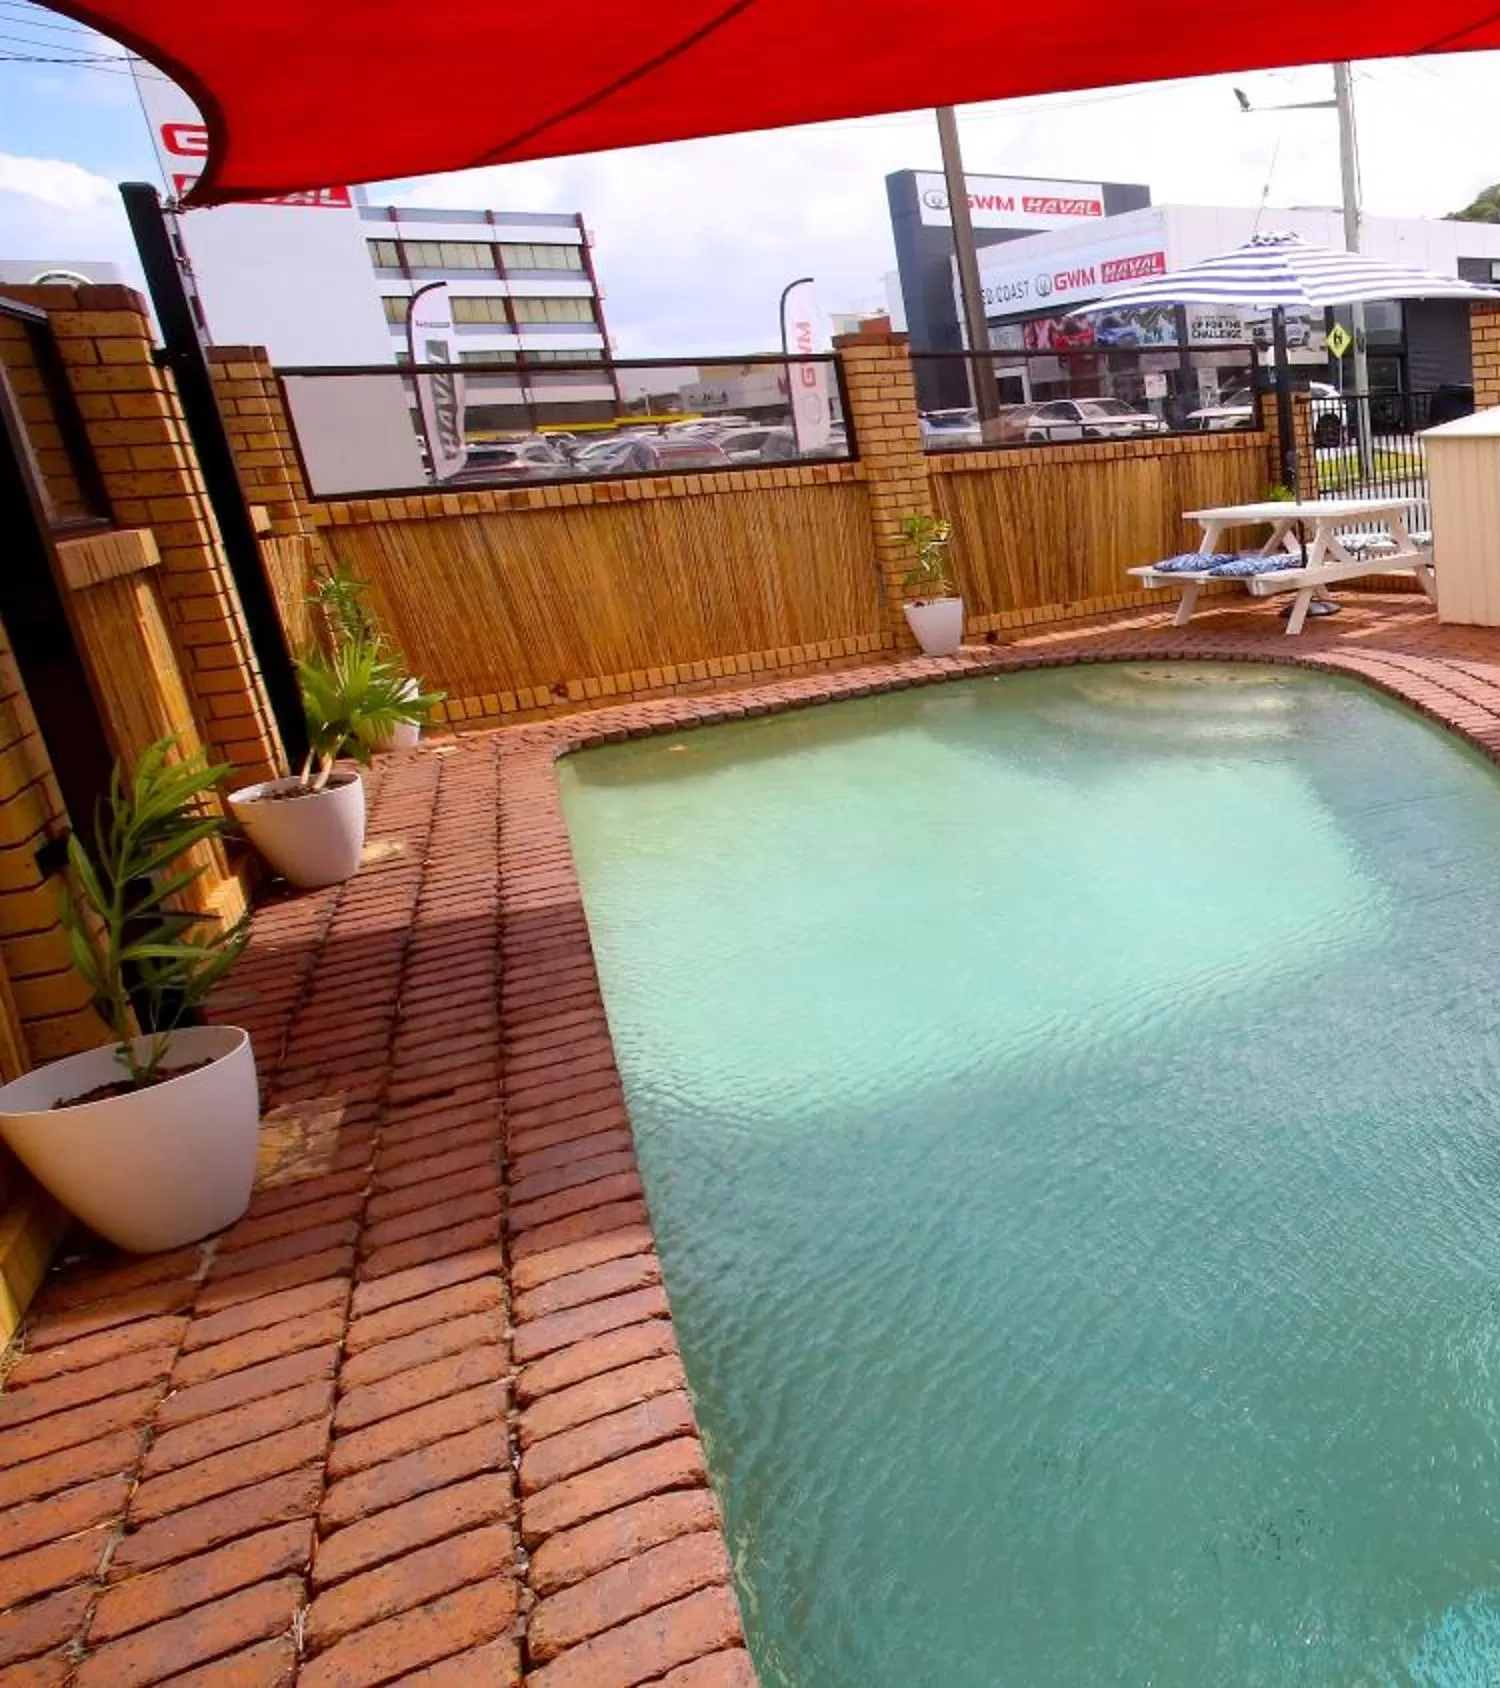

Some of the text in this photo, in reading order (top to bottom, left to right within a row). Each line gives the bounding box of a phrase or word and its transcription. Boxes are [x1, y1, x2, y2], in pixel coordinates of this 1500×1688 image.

[1024, 197, 1101, 216] HAVAL
[1054, 267, 1096, 291] GWM
[1103, 254, 1165, 282] HAVAL
